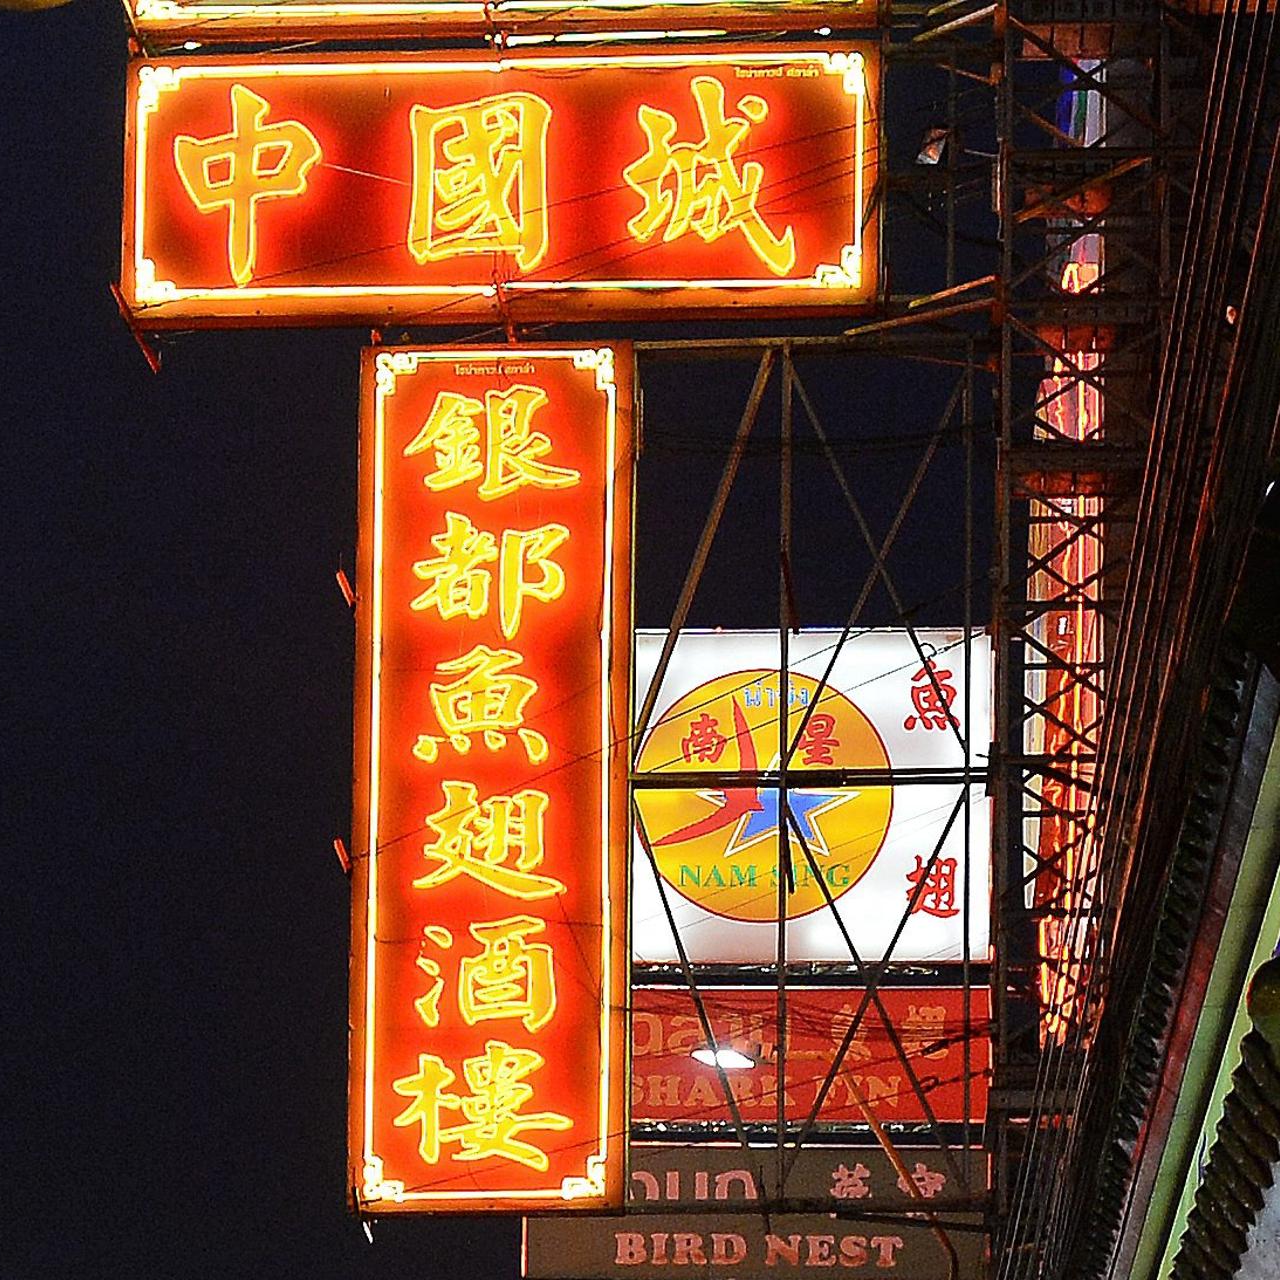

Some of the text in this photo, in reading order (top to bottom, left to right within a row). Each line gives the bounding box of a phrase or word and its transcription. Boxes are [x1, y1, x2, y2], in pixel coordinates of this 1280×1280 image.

[174, 77, 796, 287] 中國城
[681, 713, 841, 766] 南星
[393, 386, 581, 1172] 銀都魚翅酒樓
[678, 864, 758, 888] NAM
[614, 1231, 904, 1268] BIRD NEST
